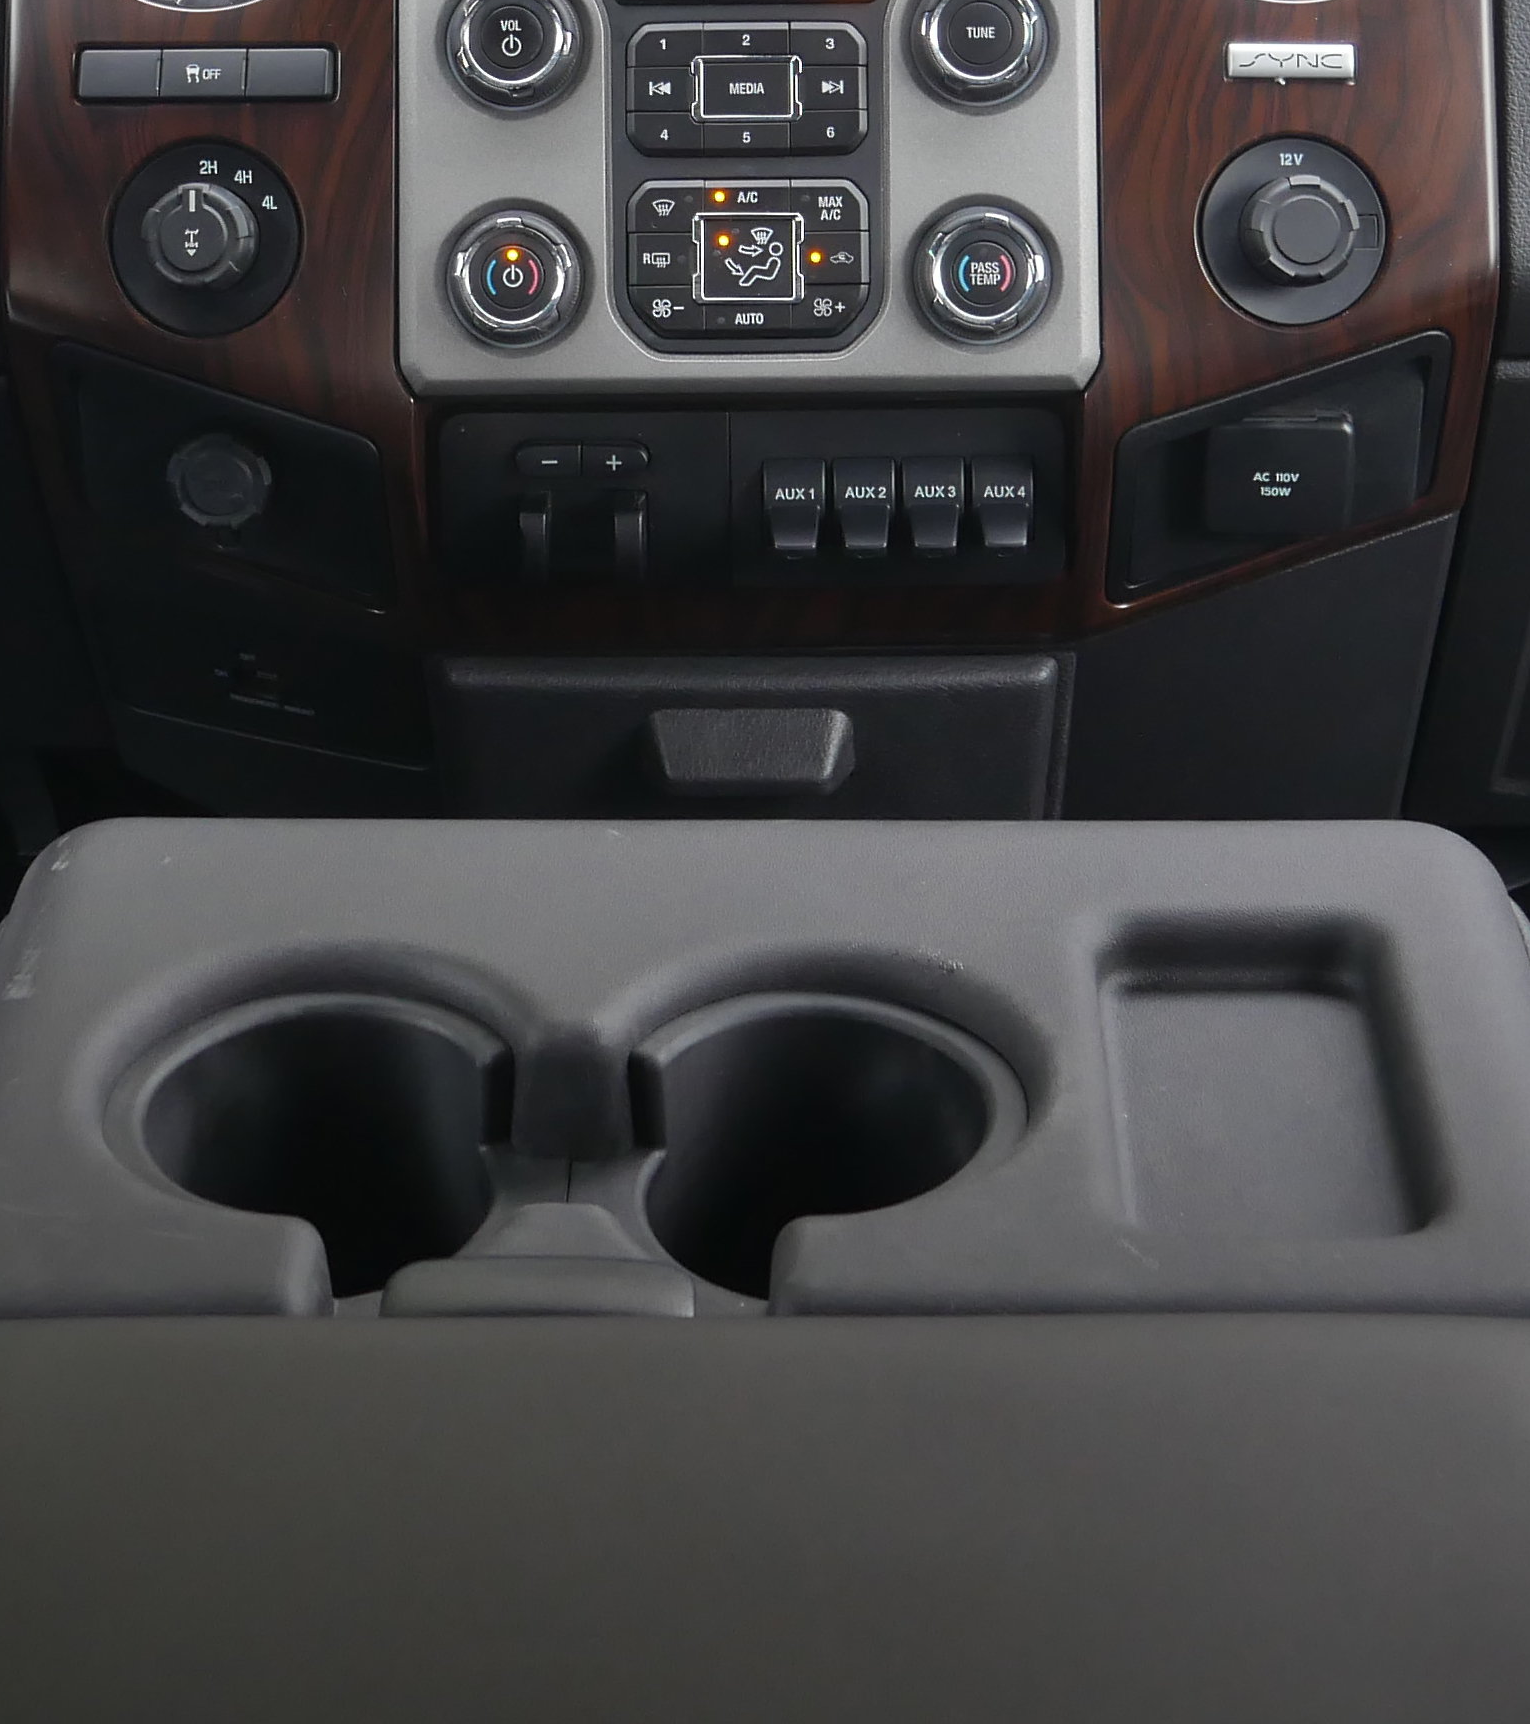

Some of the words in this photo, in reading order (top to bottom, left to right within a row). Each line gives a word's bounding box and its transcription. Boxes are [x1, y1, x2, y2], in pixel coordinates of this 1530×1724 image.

[500, 19, 522, 32] VOL
[966, 27, 996, 39] TUNE
[660, 39, 667, 50] 1
[742, 35, 751, 46] 2
[826, 38, 835, 50] 3
[1239, 53, 1343, 68] SYNC
[202, 69, 221, 80] OFF
[729, 83, 765, 95] MEDIA
[660, 129, 669, 141] 4
[742, 132, 751, 143] 5
[826, 127, 835, 138] 6
[1279, 153, 1304, 167] 12V
[199, 160, 218, 175] 2H
[234, 170, 253, 185] 4H
[262, 195, 277, 210] 4L
[737, 191, 759, 203] A/C
[818, 196, 843, 208] MAX
[820, 209, 841, 221] A/C
[971, 262, 999, 273] PASS
[970, 273, 1001, 285] TEMP
[735, 313, 764, 325] AUTO
[1253, 472, 1270, 483] AC
[1275, 472, 1299, 483] 110V
[775, 488, 803, 501] AUX
[809, 488, 816, 501] 1
[845, 487, 873, 500] AUX
[876, 487, 887, 500] 2
[914, 486, 944, 499] AUX
[947, 486, 957, 499] 3
[983, 486, 1013, 498] AUX
[1016, 486, 1027, 498] 4
[1260, 486, 1292, 497] 150W
